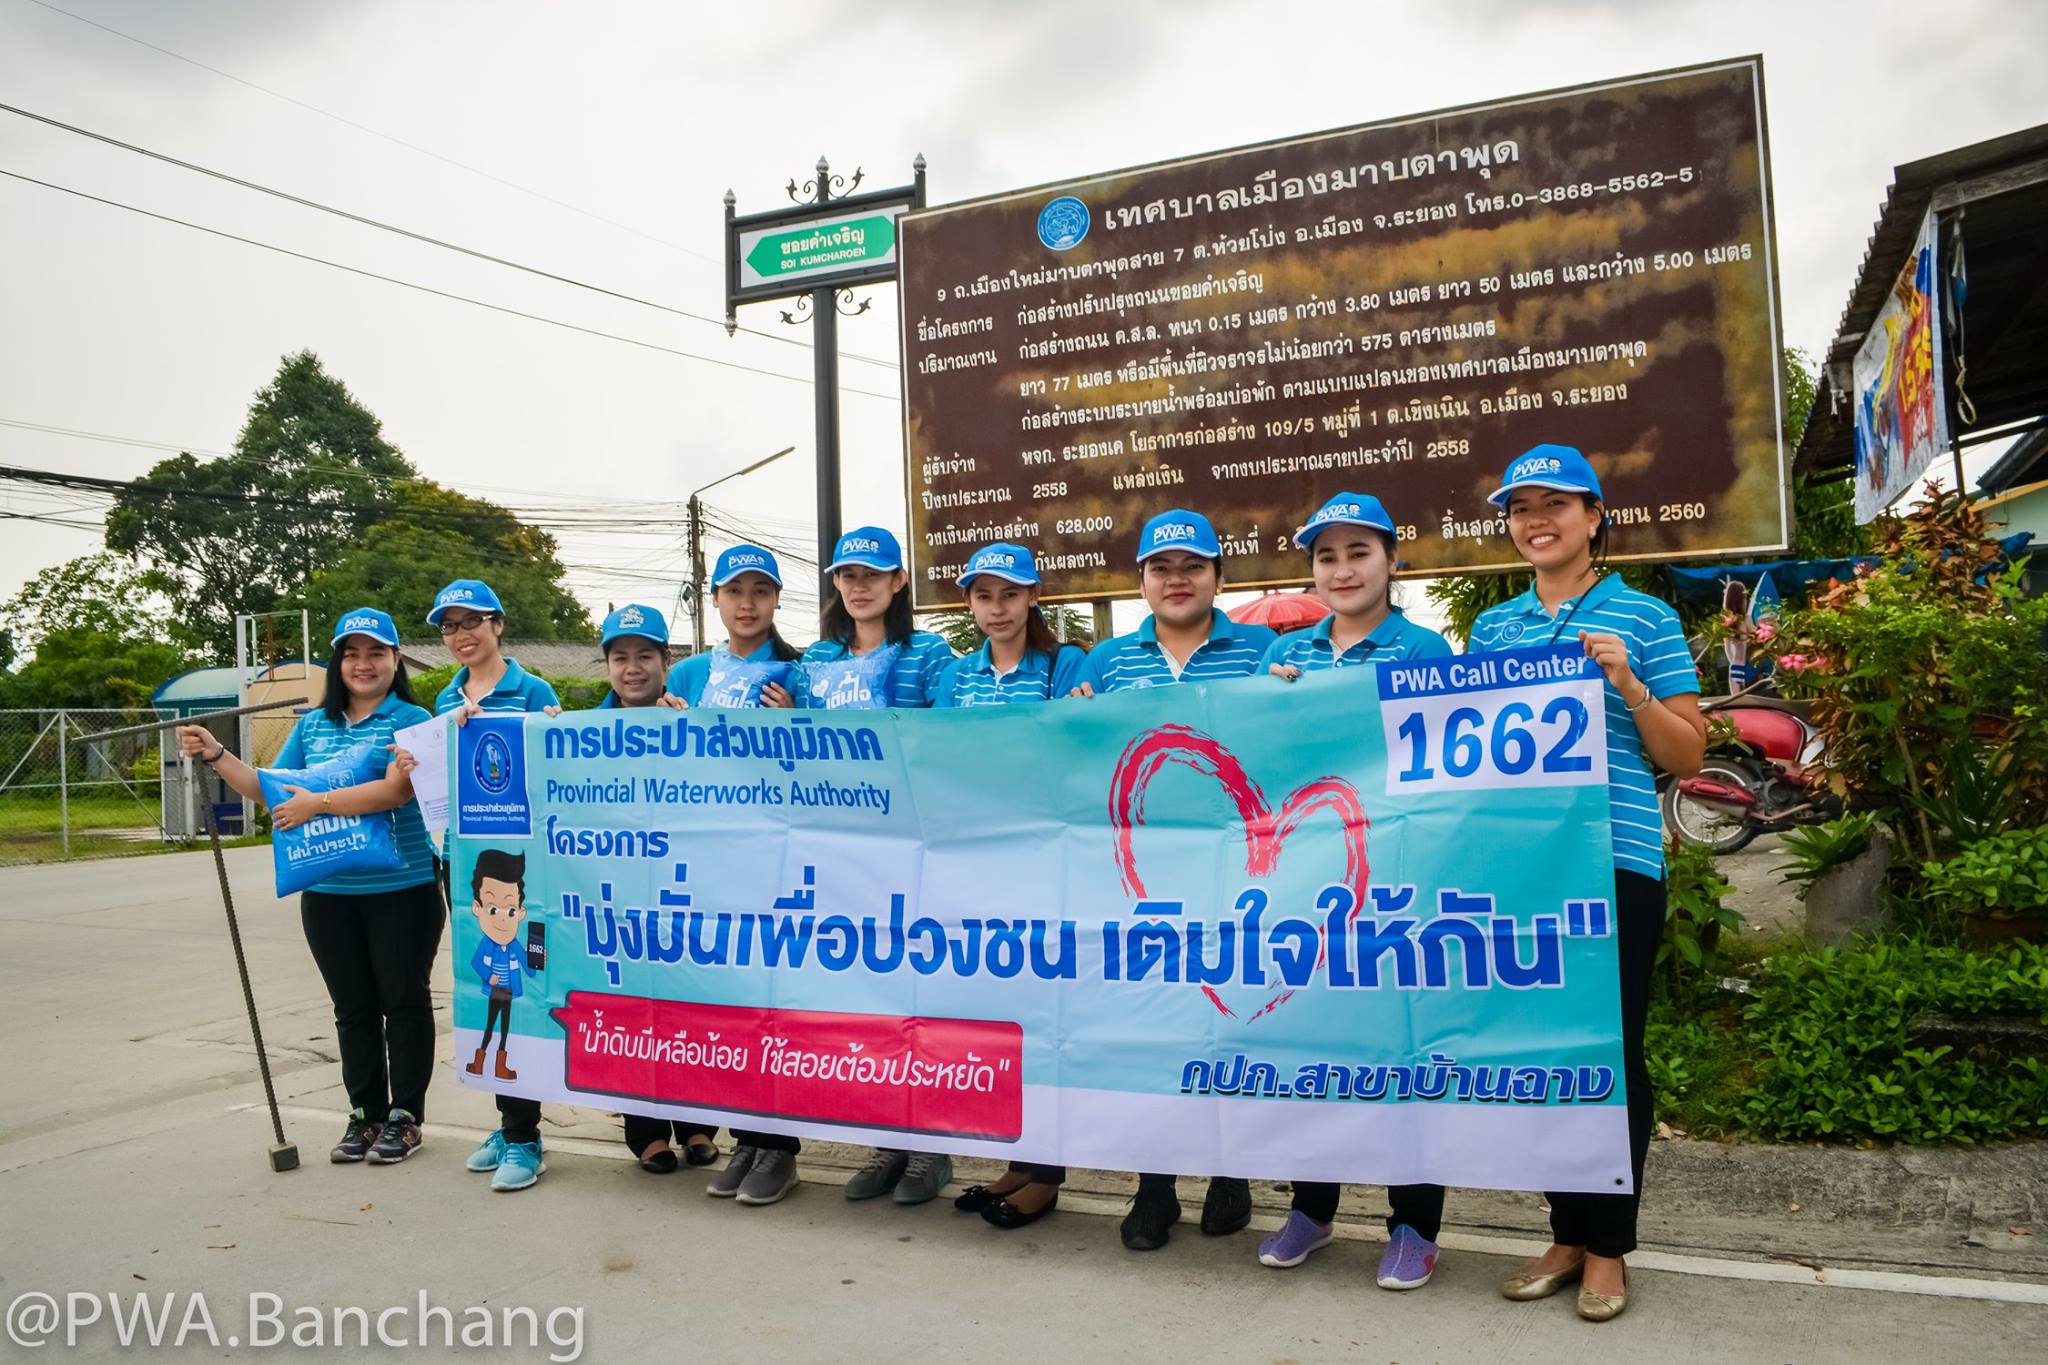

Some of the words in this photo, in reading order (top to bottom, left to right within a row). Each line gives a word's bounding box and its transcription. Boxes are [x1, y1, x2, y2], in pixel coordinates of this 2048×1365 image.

[1105, 138, 1520, 231] เทศบาลเมืองมาบตาพุด
[780, 226, 865, 254] ซอยคำเจริญ
[781, 259, 796, 270] SOI
[800, 247, 865, 266] KUMCHAROEN
[955, 249, 1164, 298] ถ.เมืองใหม่มาบตาพุดสาย
[1174, 249, 1183, 262] 7
[1193, 228, 1286, 259] ต.ห้วยโป่ง
[1296, 215, 1363, 242] อ.เมือง
[1374, 201, 1457, 229] จ.ระยอง
[1465, 167, 1694, 215] โทร.0-3868-5562-5
[917, 315, 994, 341] ชื่อโครงการ
[919, 348, 997, 375] ปริมาณงาน
[1019, 328, 1109, 360] ก่อสร้างถนน
[1115, 326, 1161, 346] ค.ส.ล.
[1169, 319, 1202, 337] หนา
[1209, 314, 1242, 332] 0.15
[1249, 308, 1288, 327] เมตร
[1296, 296, 1337, 320] กว้าง
[1345, 295, 1380, 313] 3.80
[1389, 284, 1431, 306] เมตร
[1438, 281, 1471, 299] ยาว
[1479, 277, 1500, 293] 50
[1510, 268, 1554, 291] เมตร
[1562, 251, 1646, 284] และกว้าง
[1653, 252, 1694, 270] 5.00
[1704, 242, 1752, 265] เมตร
[1020, 379, 1046, 397] ยาว
[1053, 377, 1070, 391] 77
[1077, 369, 1112, 389] เมตร
[1361, 334, 1393, 352] 575
[1399, 318, 1496, 347] ตารางเมตร
[1022, 381, 1275, 430] ก่อสร้างระบบระบายน้ำพร้อมบ่อพัก
[1282, 338, 1647, 400] ตามแบบแปลนของเทศบาลเมืองมาบตาพุด
[922, 456, 975, 484] ผู้รับจ้าง
[1022, 448, 1056, 466] หจก.
[1062, 439, 1124, 462] ระยองเค
[1131, 425, 1256, 457] โยธาการก่อสร้าง
[1264, 418, 1314, 437] 109/5
[1322, 405, 1360, 438] หมู่ที่
[1370, 410, 1377, 426] 1
[1387, 400, 1470, 425] ต.เชิงเนิน
[1480, 387, 1543, 415] อ.เมือง
[1551, 383, 1628, 407] จ.ระยอง
[922, 487, 1011, 510] ปีงบประมาณ
[1032, 481, 1067, 498] 2558
[1112, 466, 1184, 491] แหล่งเงิน
[1211, 440, 1413, 481] จากงบประมาณรายประจำปี
[1426, 440, 1470, 459] 2558
[925, 520, 1039, 547] วงเงินค่าก่อสร้าง
[1056, 515, 1113, 536] 628,000
[1659, 503, 1705, 522] 2560
[1278, 536, 1287, 551] 2
[1391, 667, 1444, 693] PWA
[1450, 660, 1497, 687] Call
[1503, 655, 1586, 680] Center
[545, 714, 884, 771] การประปาส่วนภูมิภาค
[1399, 696, 1592, 782] 1662
[547, 777, 635, 803] Provincial
[643, 778, 783, 805] Waterworks
[790, 780, 890, 815] Authority
[546, 816, 669, 858] โครงการ
[563, 863, 1078, 987] "มุ่งมั่นเพื่อปวงชน
[1102, 883, 1609, 988] เติมใจให้กัน"
[578, 1011, 748, 1072] "น้ำดิบมีเหลือน้อย
[760, 1035, 1010, 1093] ใช้สอยต้องประหยัด"
[1179, 1054, 1614, 1101] กปภ.สาขาบ้านฉาง
